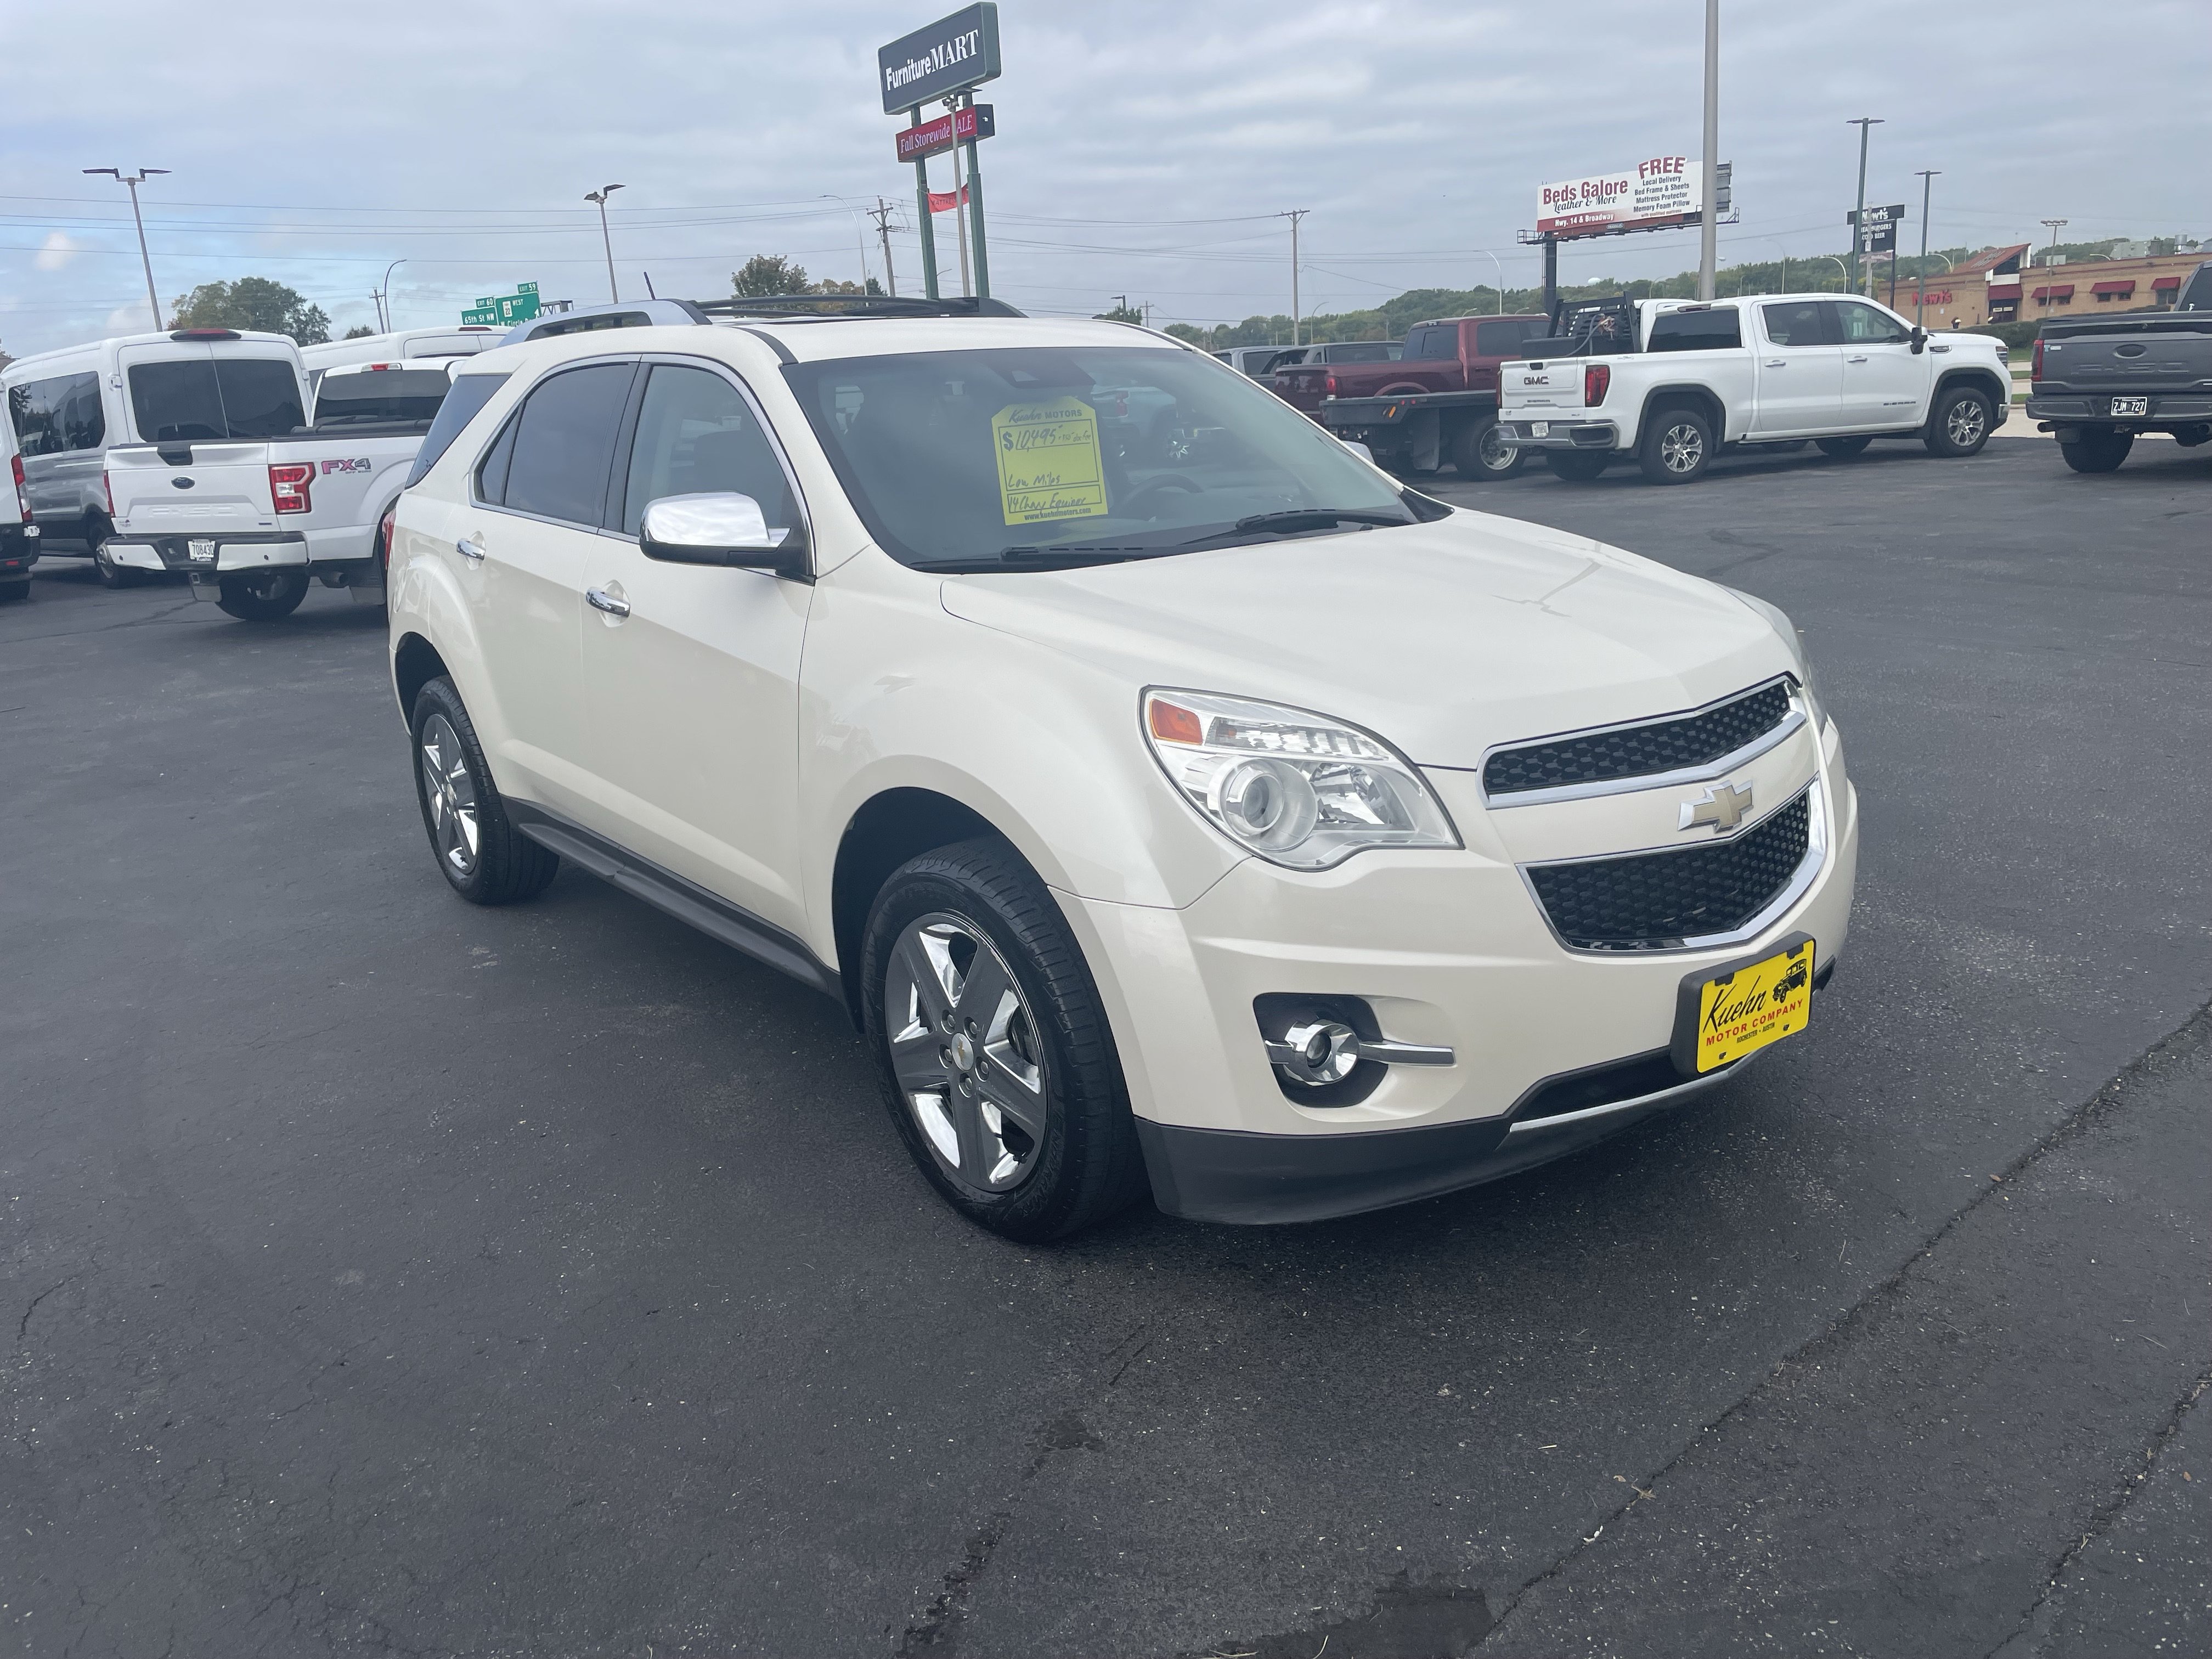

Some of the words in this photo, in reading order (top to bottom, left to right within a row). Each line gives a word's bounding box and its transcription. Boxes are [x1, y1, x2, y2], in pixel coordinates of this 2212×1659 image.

[900, 135, 913, 154] Fall
[915, 122, 950, 148] Storewide
[956, 115, 973, 134] ALE
[1638, 157, 1686, 180] FREE
[1643, 178, 1657, 186] Local
[1543, 185, 1577, 205] Beds
[1581, 179, 1628, 199] Galore
[1636, 195, 1660, 204] Mattress
[1661, 191, 1688, 201] Protector
[1554, 199, 1583, 213] Leather
[1585, 196, 1592, 206] &
[1595, 194, 1617, 205] More
[1633, 205, 1655, 213] Memory
[1555, 219, 1568, 227] Hwy.
[1585, 213, 1614, 222] Broadway
[1861, 207, 1888, 222] Nwt's
[465, 315, 478, 324] 65th
[479, 313, 485, 322] St
[487, 313, 494, 321] NW
[1524, 376, 1549, 385] GMC
[2113, 402, 2127, 411] ZJM
[2131, 402, 2145, 411] 727
[1009, 408, 1042, 424] Kuehn
[1045, 409, 1082, 419] MOTORS
[321, 458, 371, 475] FX4
[1033, 471, 1060, 486] Miles
[1049, 492, 1086, 511] Equinox
[1024, 507, 1092, 521] www.kuehnmotors.com
[1703, 975, 1767, 1033] Kuehn
[1706, 1023, 1747, 1046] MOTOR
[1752, 998, 1803, 1028] COMPANY
[1737, 1029, 1758, 1043] ROCHESTER
[1762, 1022, 1775, 1032] AUSTIN
